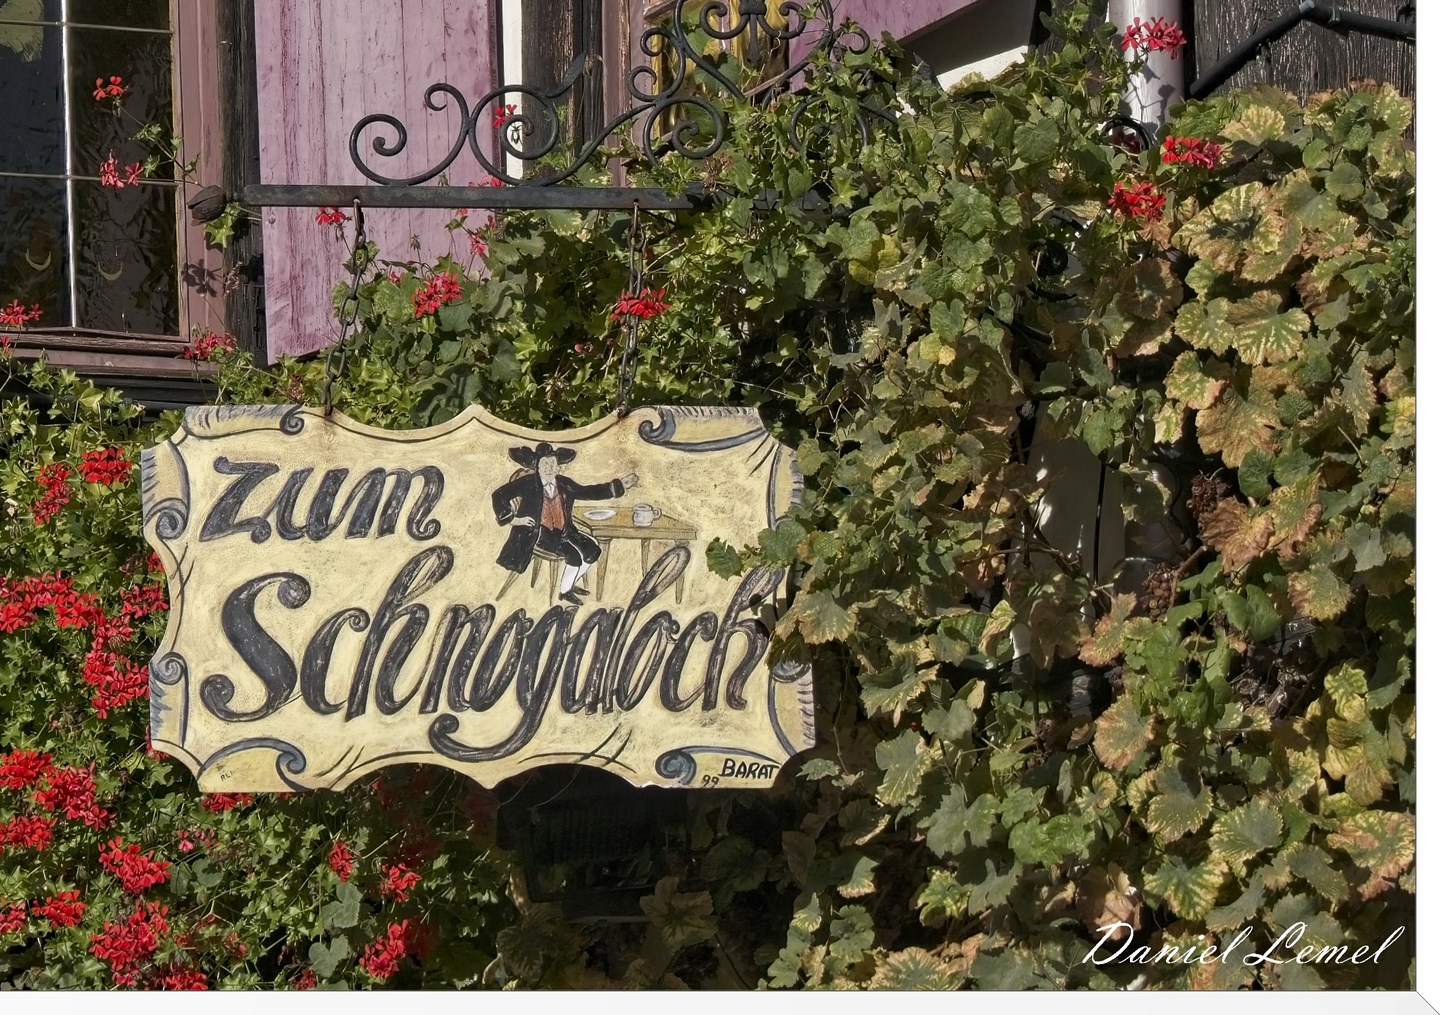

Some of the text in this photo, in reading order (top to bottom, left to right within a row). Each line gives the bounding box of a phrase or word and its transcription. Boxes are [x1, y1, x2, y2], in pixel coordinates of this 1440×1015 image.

[200, 545, 785, 761] Schnogaloch
[718, 758, 780, 780] BARAT
[702, 775, 719, 788] 99
